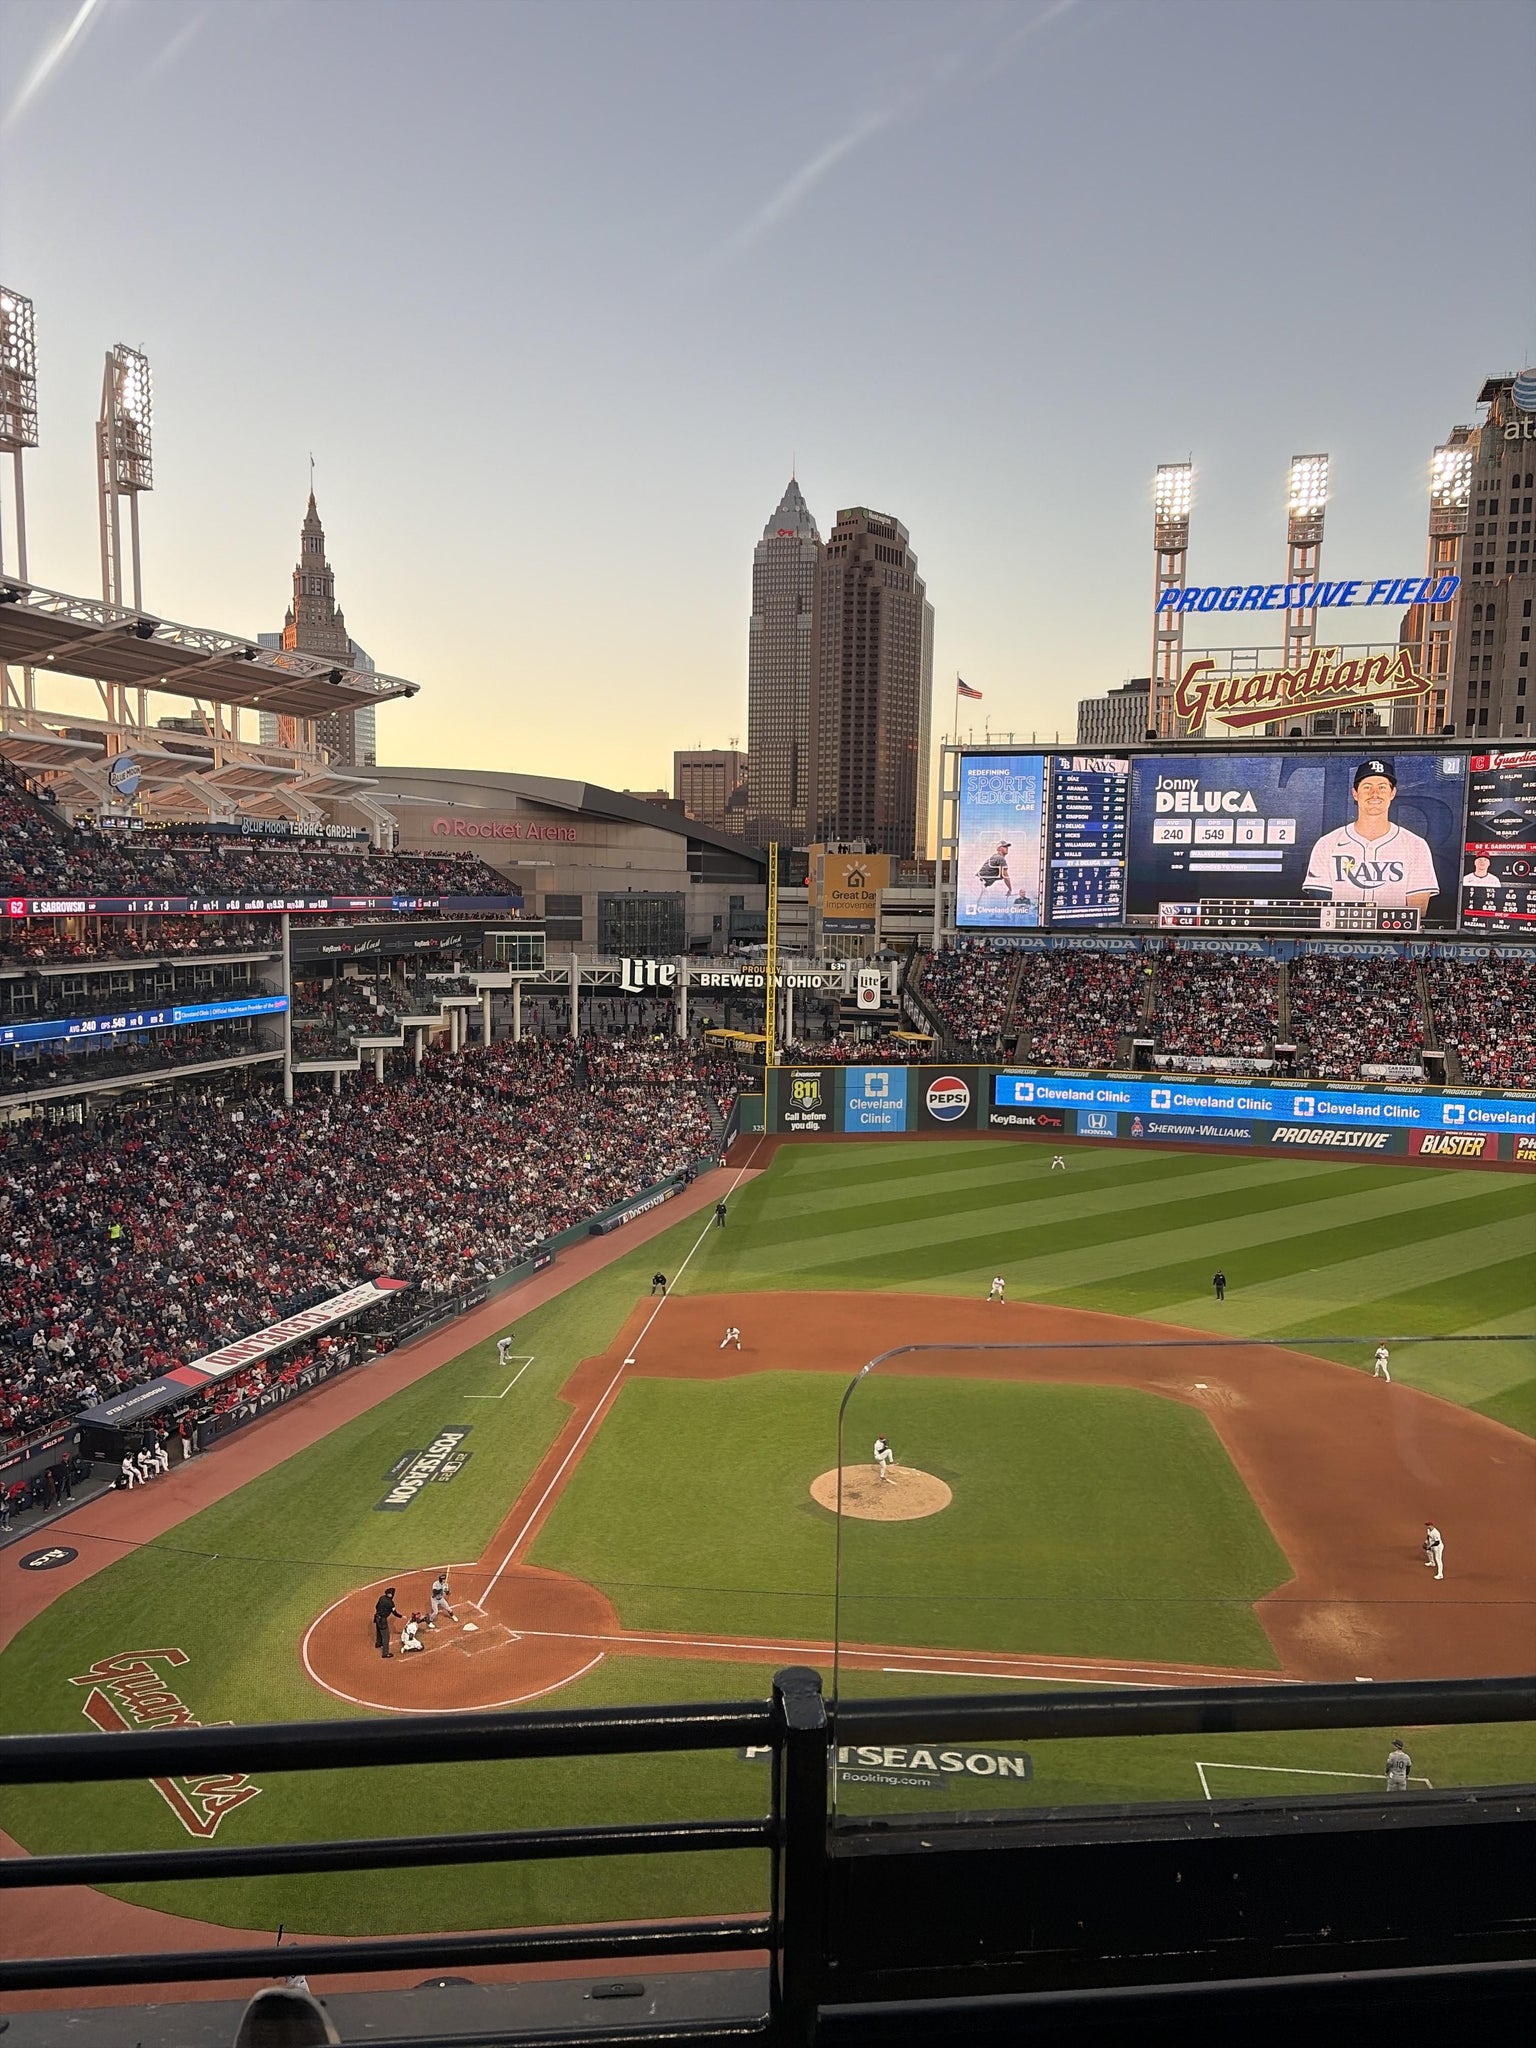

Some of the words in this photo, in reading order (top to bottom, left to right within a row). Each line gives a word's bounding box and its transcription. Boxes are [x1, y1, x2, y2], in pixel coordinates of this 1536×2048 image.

[1155, 581, 1361, 613] PROGRESSIVE
[1367, 575, 1461, 605] FIELD
[1174, 646, 1432, 734] Guardians
[1058, 757, 1070, 769] TB
[1083, 758, 1116, 773] RAYS
[1369, 761, 1384, 773] TB
[1446, 761, 1455, 771] 21
[112, 772, 126, 785] BLUE
[126, 767, 140, 778] MOON
[967, 776, 1036, 791] SPORTS
[1155, 775, 1199, 791] Jonny
[967, 791, 1036, 804] MEDICINE
[1156, 791, 1257, 812] DELUCA
[242, 817, 263, 834] BLUE
[264, 820, 287, 831] MOON
[289, 821, 324, 837] TERRACE
[325, 824, 357, 839] GARDEN
[454, 819, 521, 839] Rocket
[526, 822, 577, 841] Arena
[1161, 829, 1184, 840] .240
[1202, 829, 1224, 840] .549
[1246, 829, 1253, 840] 0
[1279, 829, 1286, 840] 2
[1332, 855, 1404, 889] RAYS
[832, 890, 859, 900] Great
[11, 902, 23, 913] 62
[33, 902, 41, 912] E.
[41, 901, 85, 912] SABROWSKI
[148, 901, 153, 911] 2
[164, 901, 169, 910] 3
[211, 901, 219, 909] 1-1
[231, 900, 240, 909] 6.0
[251, 900, 264, 909] 6.00
[273, 900, 284, 909] 9.53
[317, 900, 327, 908] 1.00
[322, 945, 342, 953] KeyBank
[414, 940, 430, 948] KeyBank
[1069, 938, 1136, 949] HONDA
[1191, 941, 1263, 951] HONDA
[1324, 944, 1398, 954] HONDA
[619, 958, 677, 993] Lite
[700, 974, 763, 988] BREWED
[787, 975, 821, 988] OHIO
[860, 976, 879, 988] Lite
[182, 1010, 199, 1018] Cleveland
[81, 1021, 96, 1032] .240
[111, 1018, 126, 1028] .549
[138, 1015, 143, 1025] 0
[159, 1013, 163, 1022] 2
[794, 1081, 818, 1098] 811
[1160, 1075, 1198, 1083] PROGRESSIVE
[1327, 1083, 1366, 1091] PROGRESSIVE
[1384, 1086, 1424, 1094] PROGRESSIVE
[1442, 1088, 1484, 1096] PROGRESSIVE
[930, 1094, 967, 1104] PEPSI
[1037, 1087, 1094, 1101] Cleveland
[1096, 1090, 1130, 1103] Clinic
[1174, 1094, 1234, 1108] Cleveland
[1237, 1097, 1272, 1110] Clinic
[850, 1098, 903, 1109] Cleveland
[1317, 1102, 1380, 1117] Cleveland
[1383, 1106, 1420, 1118] Clinic
[802, 1112, 827, 1120] before
[860, 1113, 891, 1123] Clinic
[990, 1114, 1036, 1126] KeyBank
[1468, 1109, 1535, 1124] Cleveland
[791, 1123, 805, 1131] you
[806, 1121, 820, 1130] dig.
[1271, 1128, 1389, 1148] PROGRESSIVE
[1420, 1135, 1486, 1156] BLASTER
[206, 1312, 331, 1366] CLEVELAND
[126, 1386, 167, 1406] PROGRESSIVE
[106, 1405, 126, 1415] FIELD
[384, 1433, 464, 1503] POSTSEASON
[29, 1549, 63, 1566] ALCS
[842, 1772, 931, 1787] Booking.com
